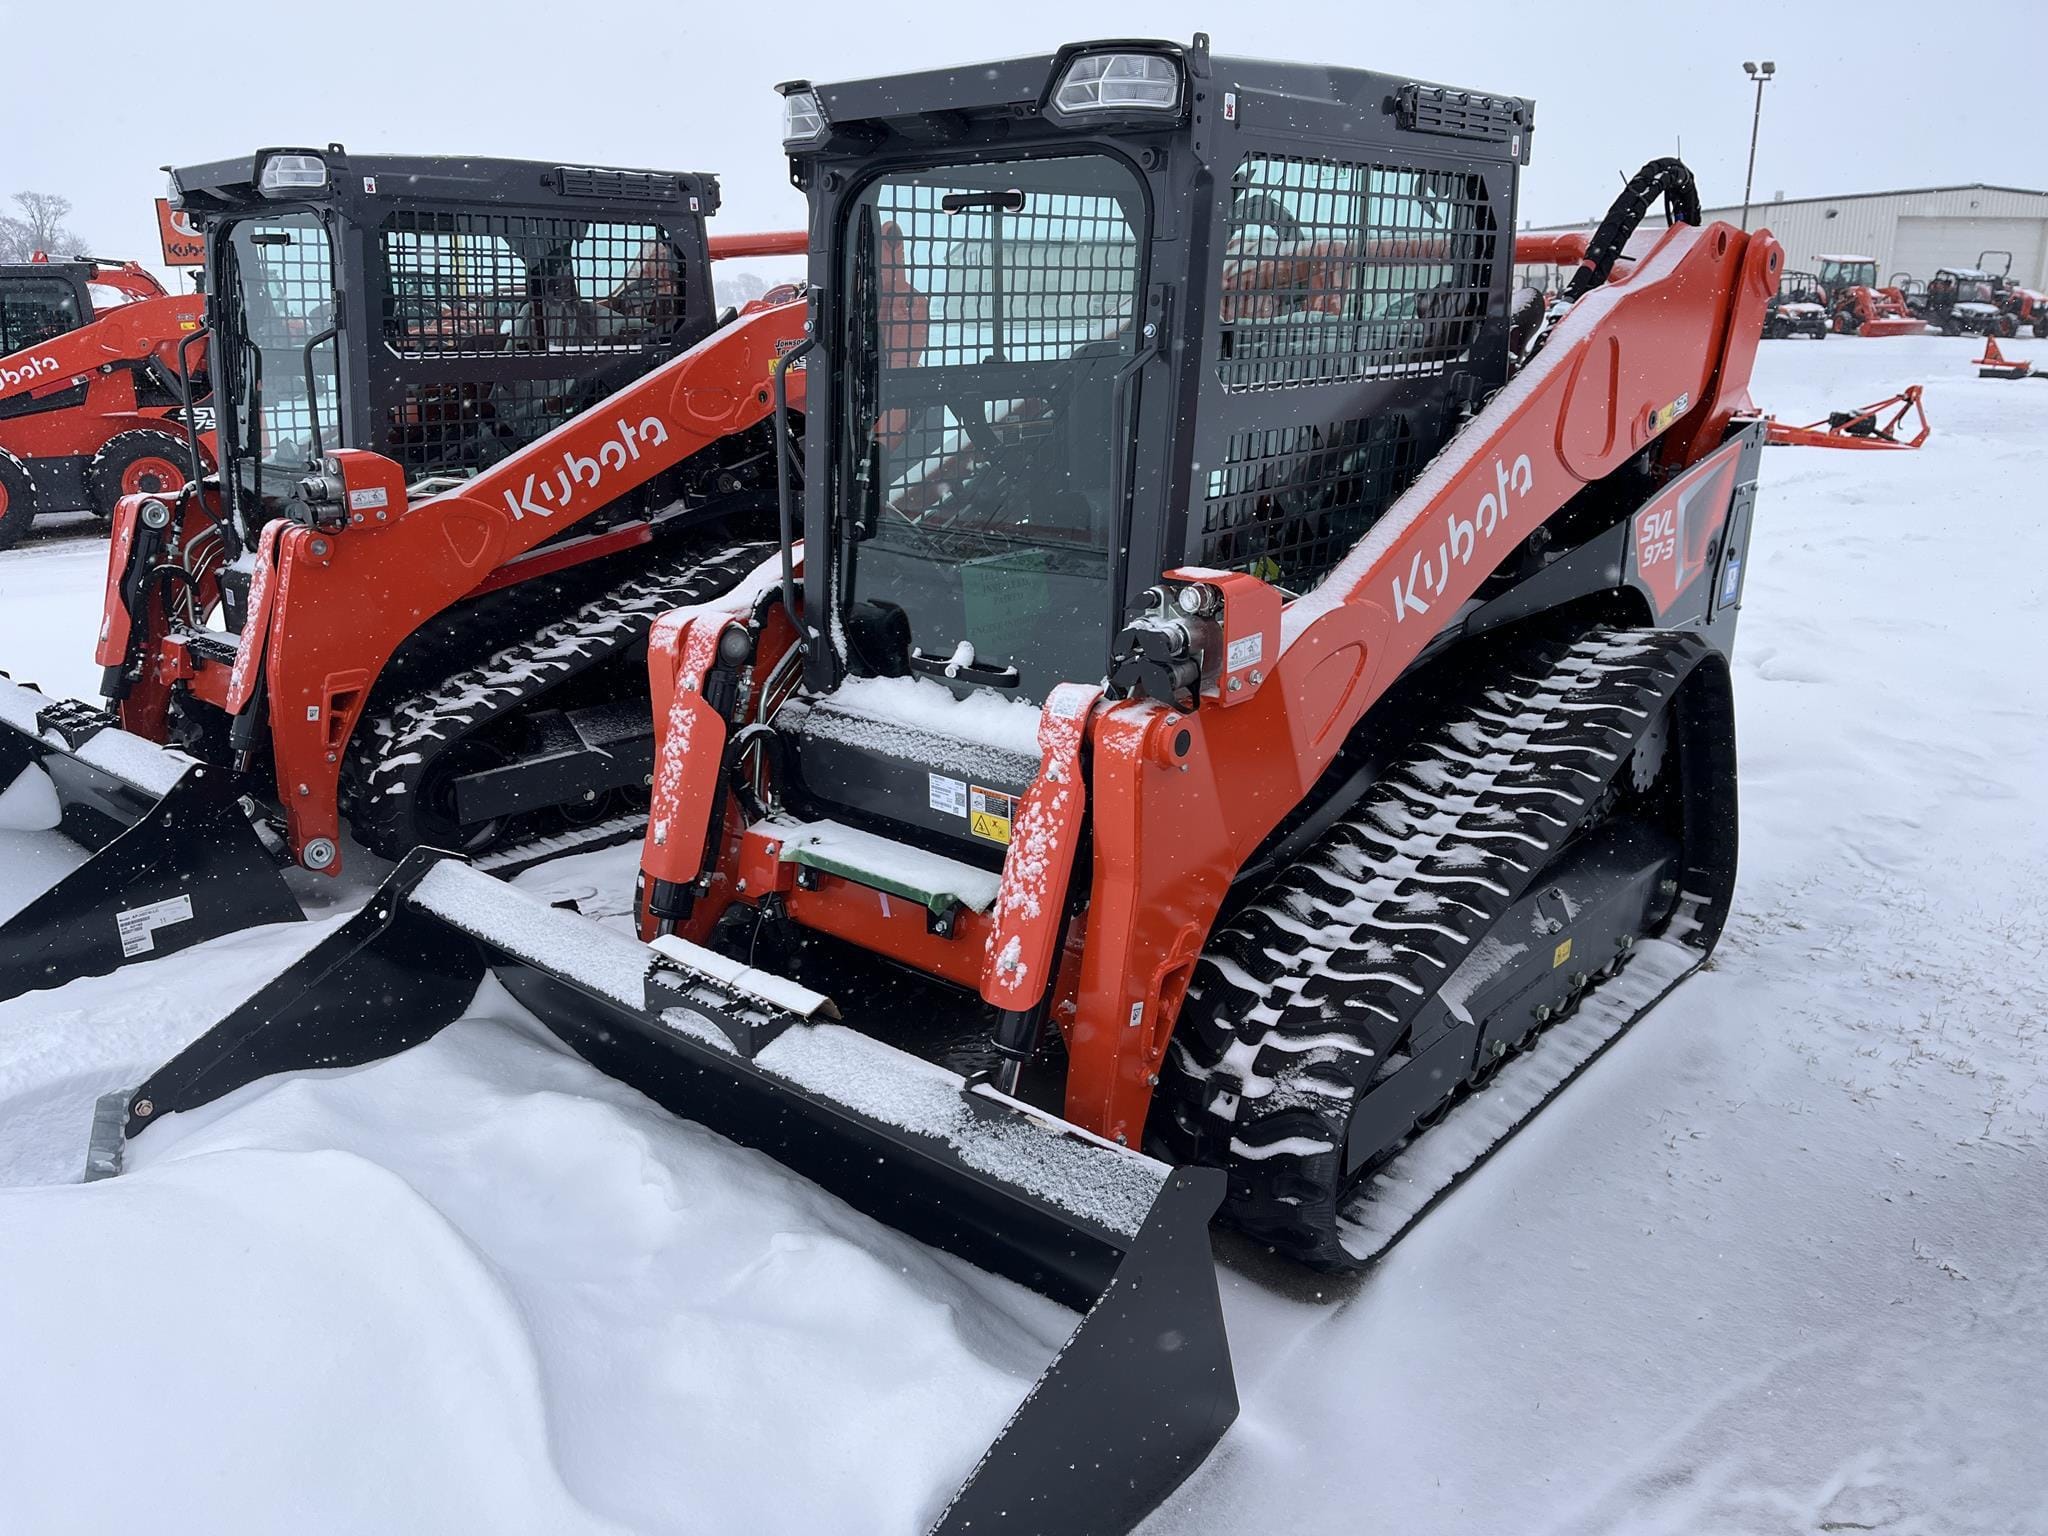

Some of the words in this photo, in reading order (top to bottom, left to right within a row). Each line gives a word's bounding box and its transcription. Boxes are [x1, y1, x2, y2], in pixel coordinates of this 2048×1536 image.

[503, 416, 669, 521] Kubota
[1392, 454, 1533, 624] Kubota
[1640, 509, 1676, 544] SVL
[1641, 538, 1675, 568] 97-3
